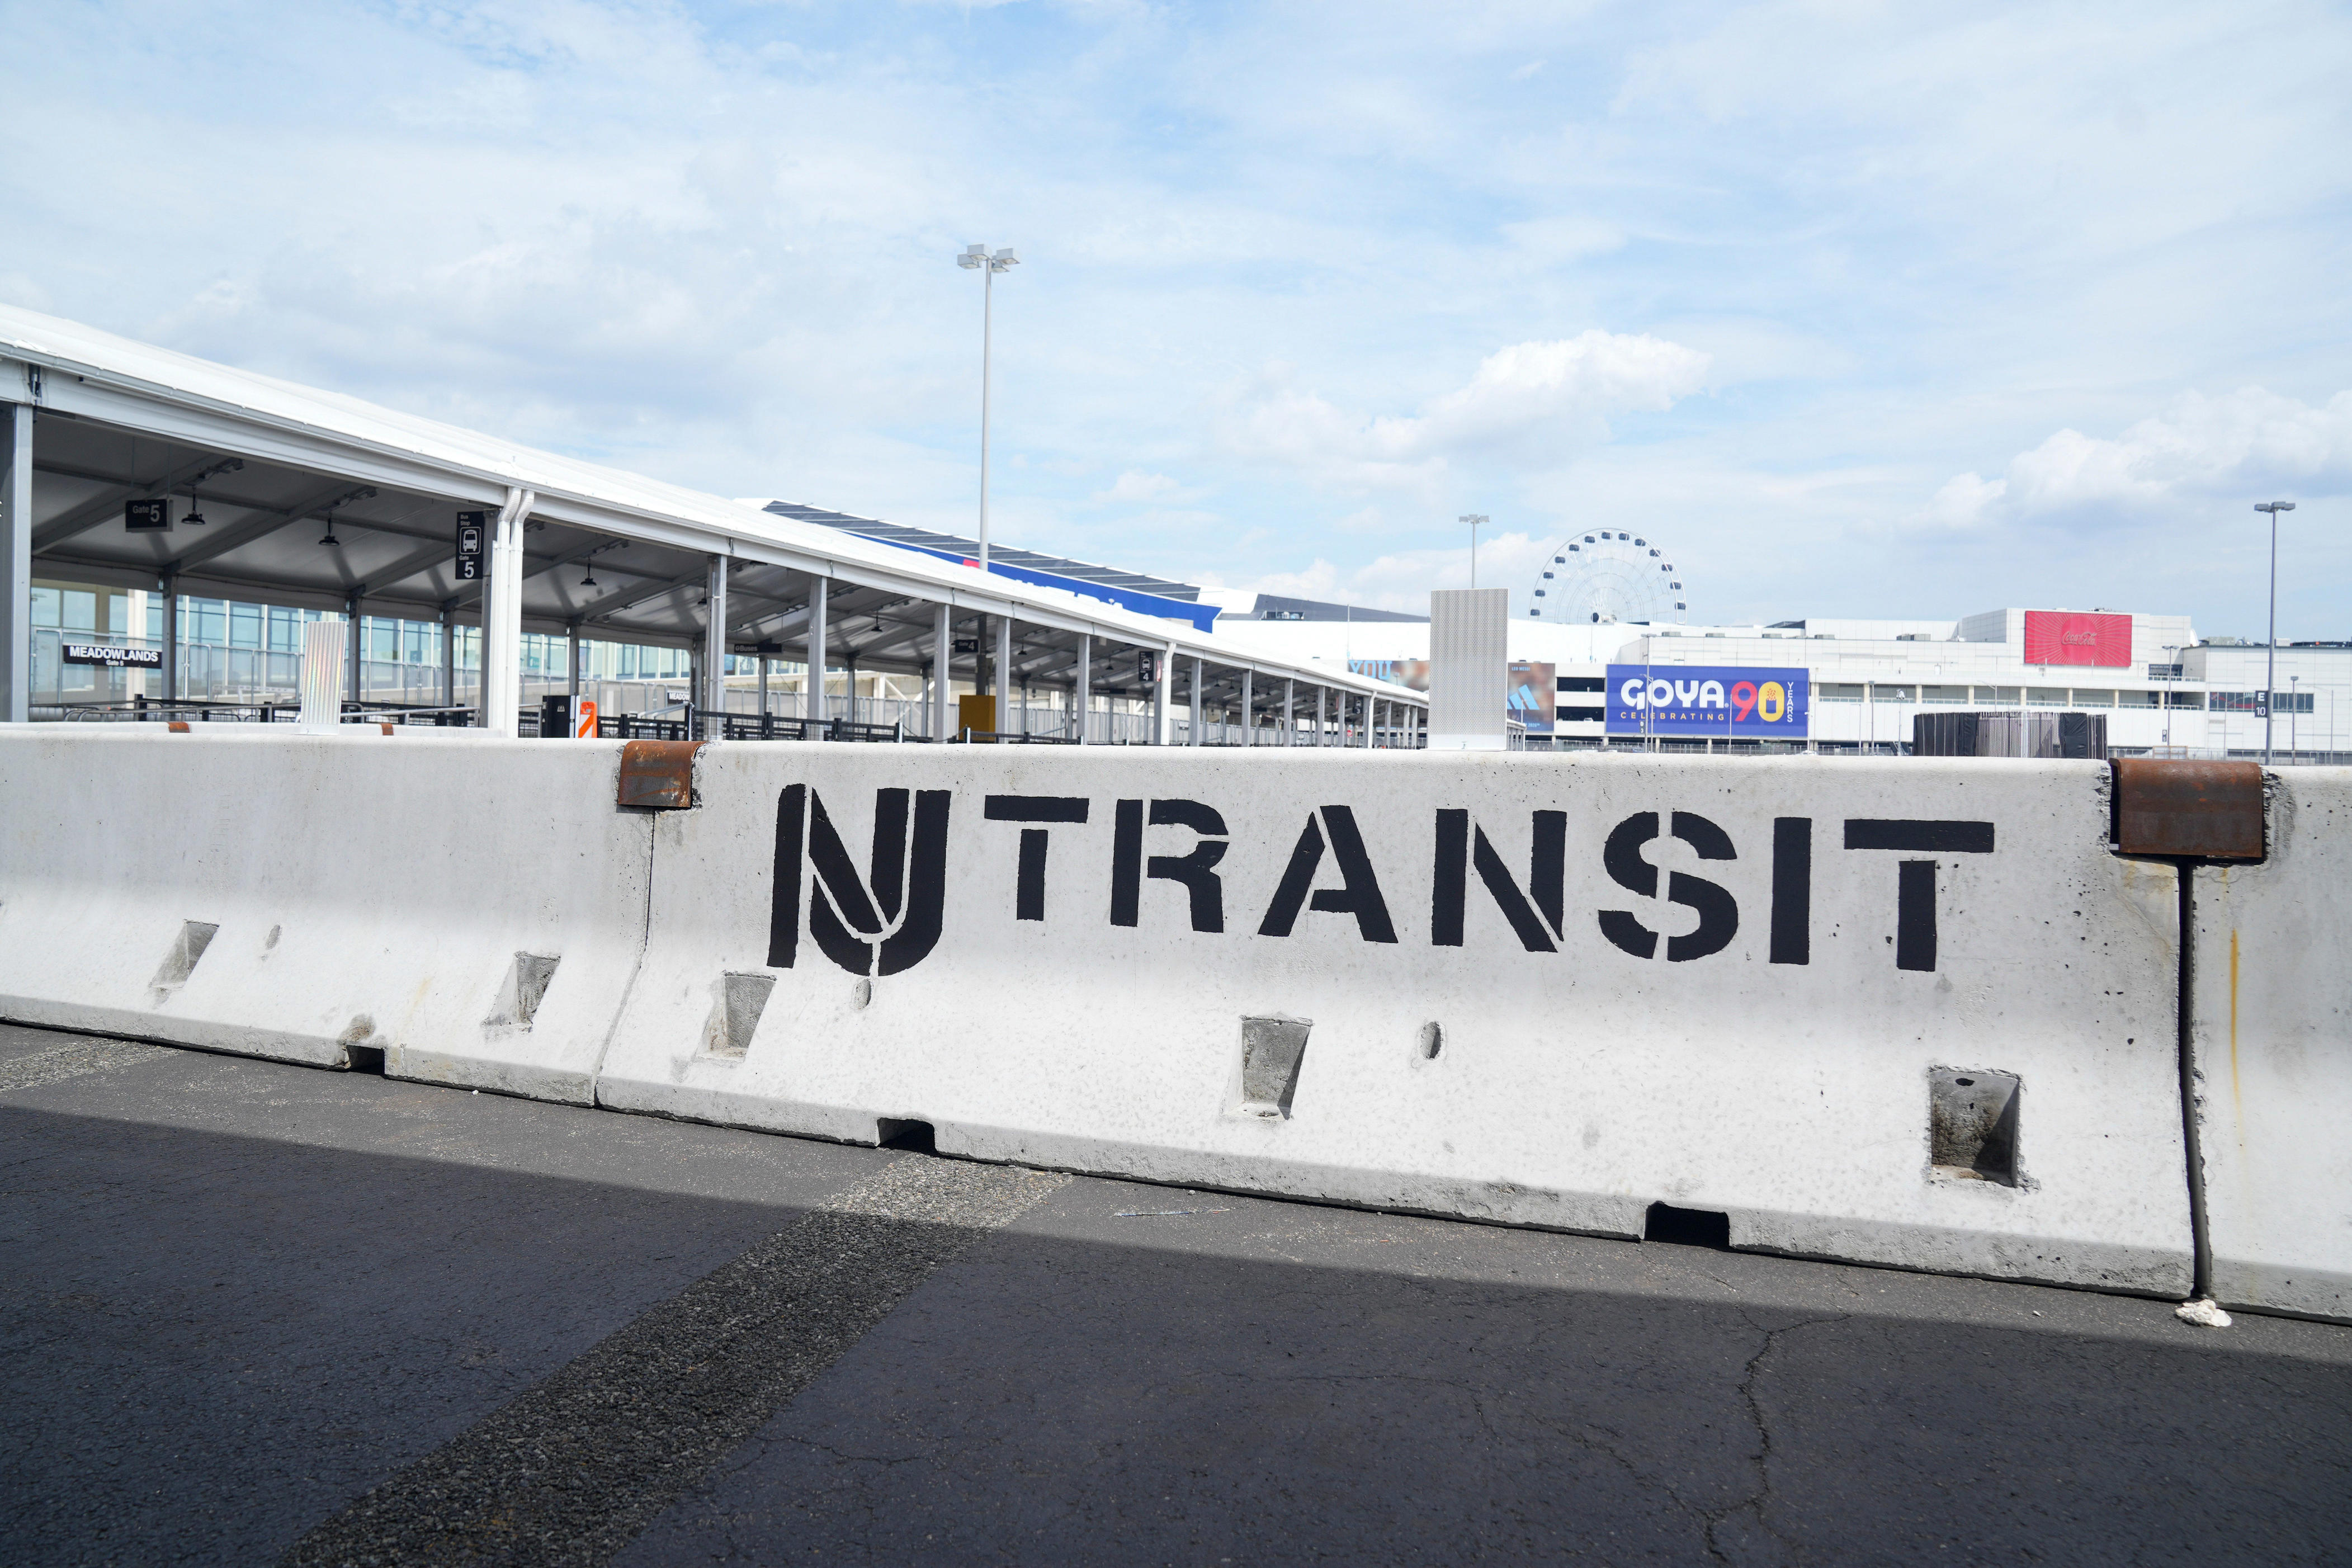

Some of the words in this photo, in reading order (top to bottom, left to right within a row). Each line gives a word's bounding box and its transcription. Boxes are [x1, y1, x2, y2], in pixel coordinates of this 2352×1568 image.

[133, 505, 149, 513] Gate
[150, 504, 160, 522] 5
[464, 561, 474, 578] 5
[969, 641, 975, 650] 4
[69, 646, 158, 662] MEADOWLANDS
[1348, 660, 1392, 679] YOU
[1731, 681, 1784, 722] 90
[2257, 692, 2265, 701] E
[1621, 712, 1725, 721] CELEBRATING
[2256, 706, 2266, 716] 10
[984, 795, 1995, 972] TRANSIT
